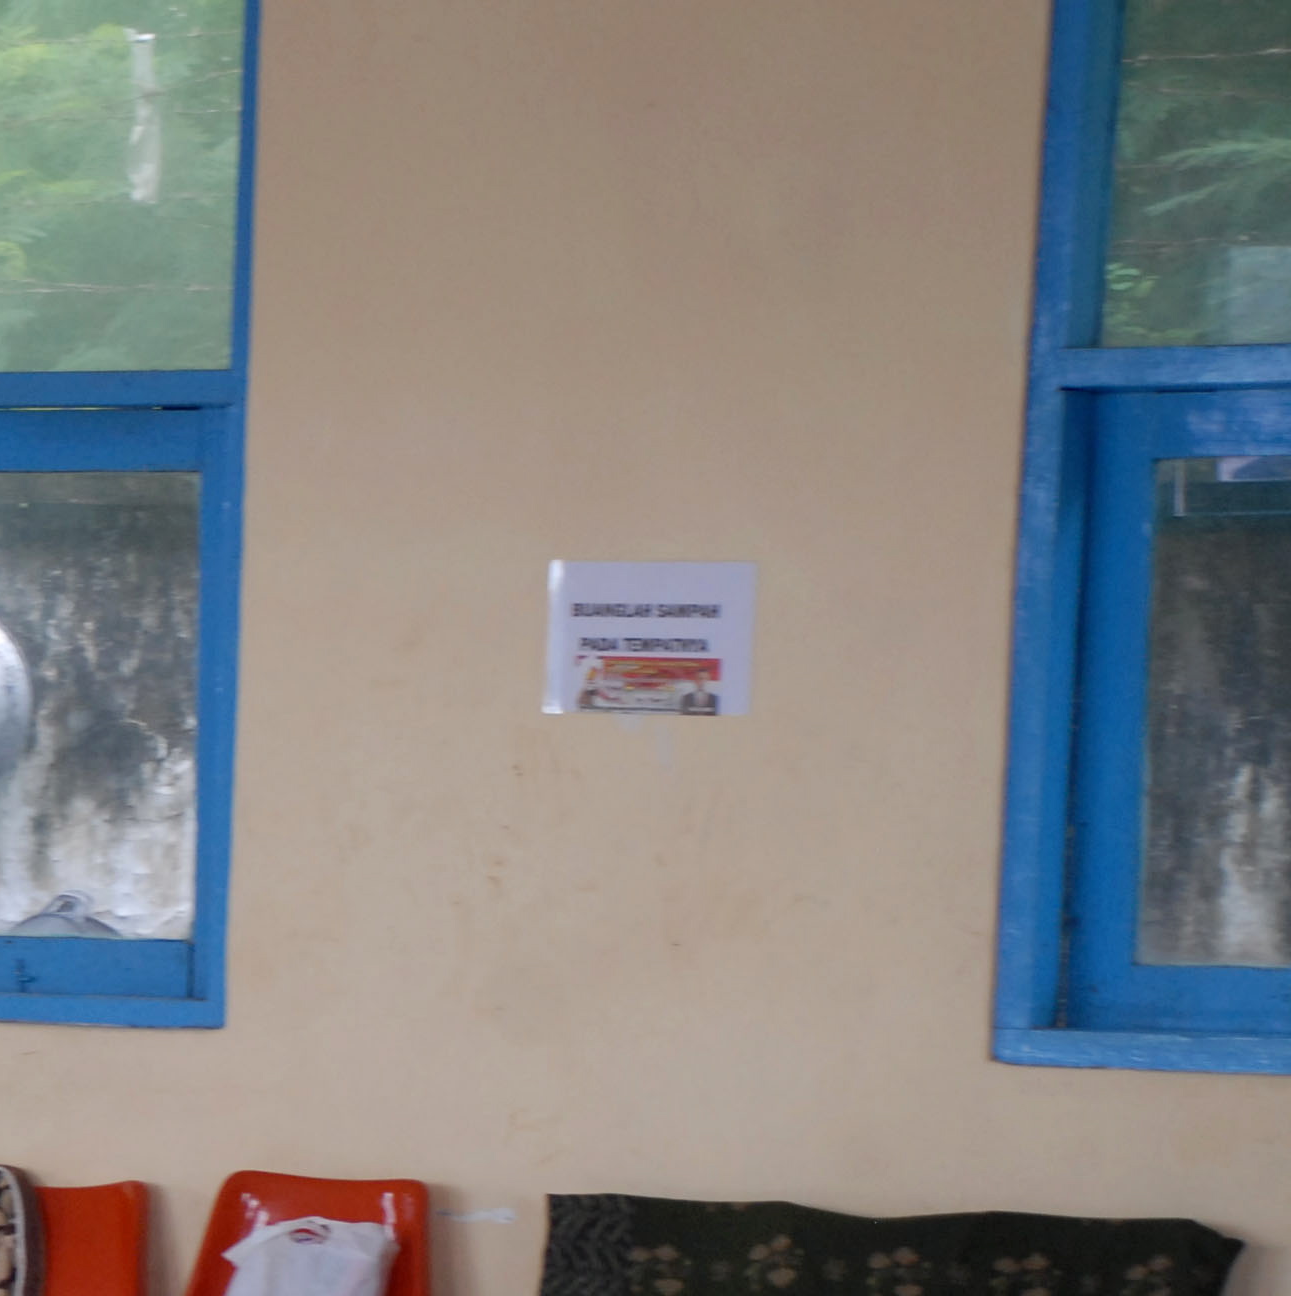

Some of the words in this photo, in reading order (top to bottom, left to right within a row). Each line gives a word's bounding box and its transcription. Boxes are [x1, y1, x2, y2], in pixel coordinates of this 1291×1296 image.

[656, 604, 721, 618] SAMPAH
[579, 637, 619, 651] PADA
[622, 638, 710, 652] TEMPATNYA
